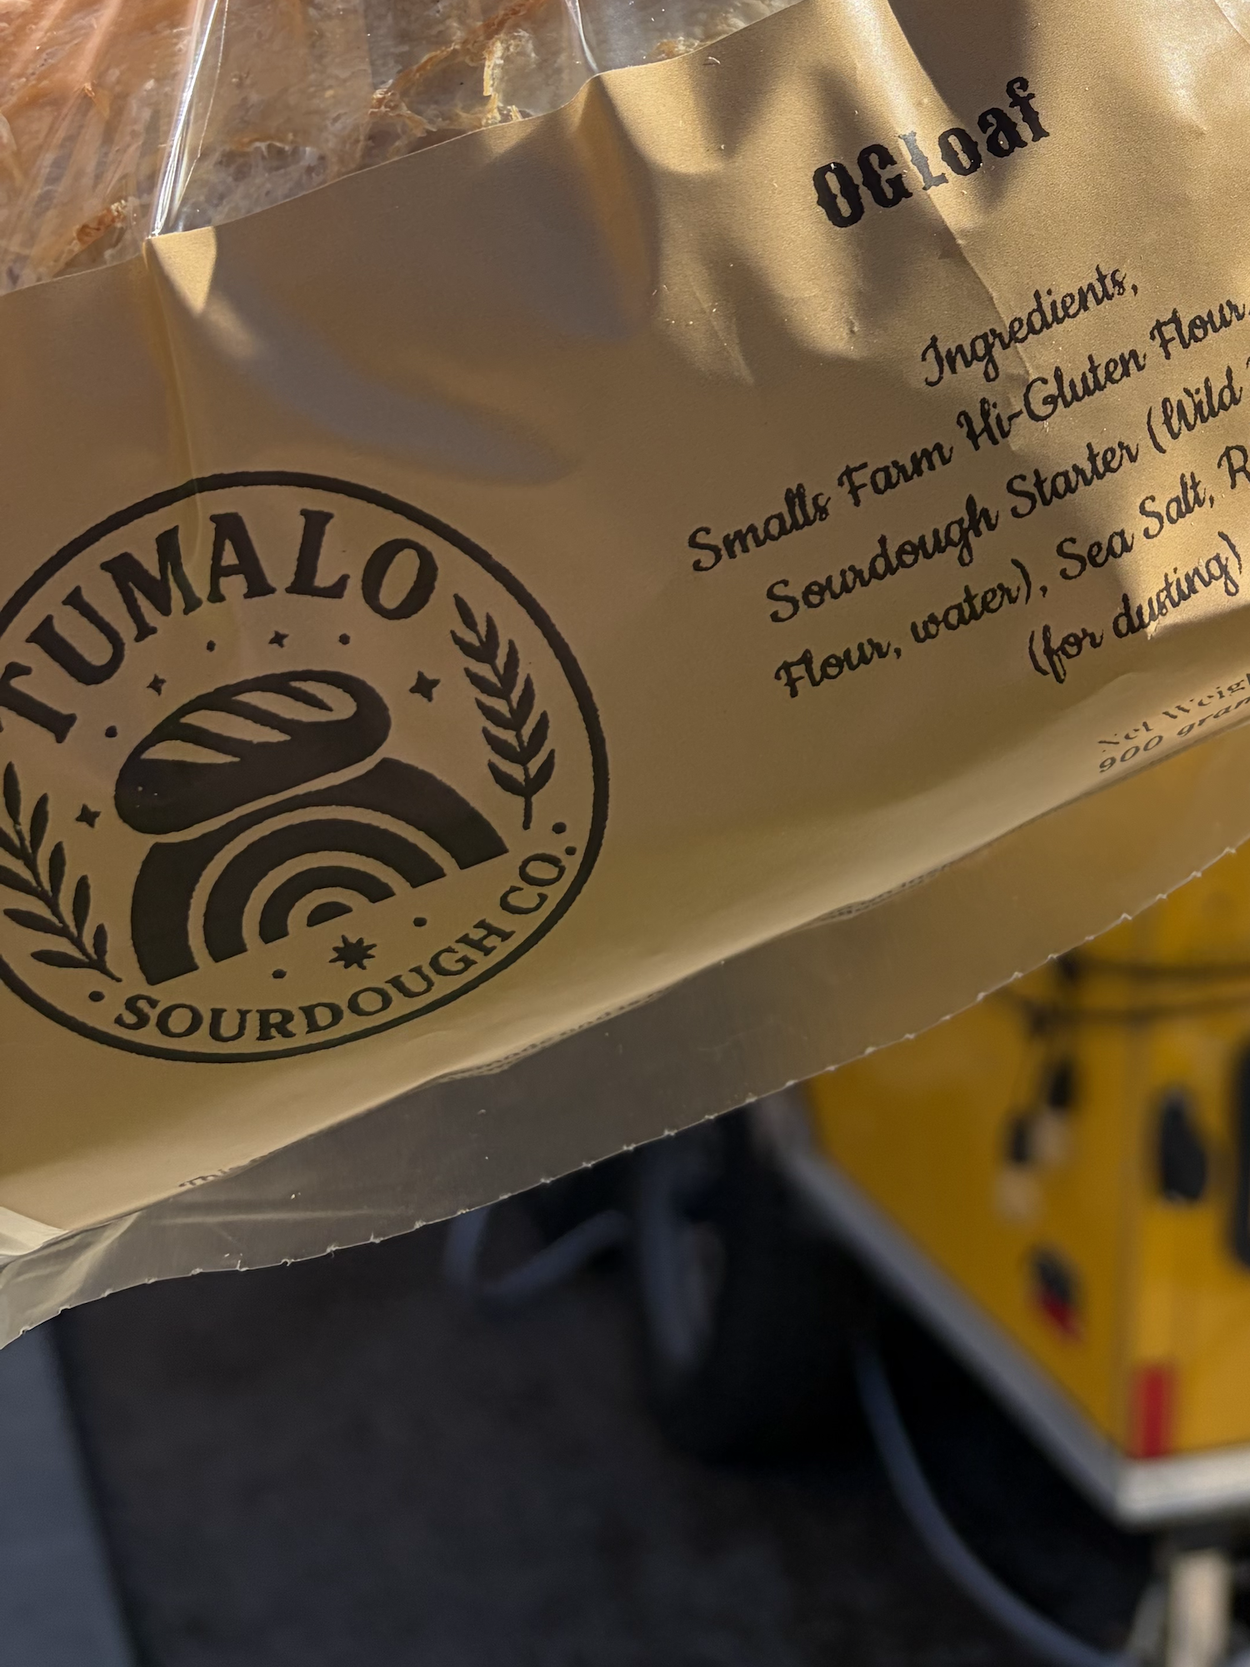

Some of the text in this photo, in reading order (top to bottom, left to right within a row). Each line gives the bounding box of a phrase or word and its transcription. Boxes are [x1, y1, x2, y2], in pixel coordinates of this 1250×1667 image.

[921, 264, 1138, 387] Ingredients,
[688, 483, 831, 572] Smalls
[838, 442, 953, 507] Farm
[956, 348, 1147, 451] Hi-Gluten
[766, 494, 999, 622] Sourdough
[1006, 440, 1138, 519] Starter
[1146, 365, 1243, 454] (Wild
[0, 508, 440, 744] TUMALO
[774, 638, 902, 698] Flour,
[910, 558, 1048, 643] water),
[1056, 528, 1134, 581] Sea
[1138, 471, 1214, 539] Salt,
[1028, 531, 1243, 684] (for dusting)
[1098, 735, 1164, 773] 900
[113, 917, 516, 1043] SOURDOUGH
[500, 843, 578, 916] CO.
